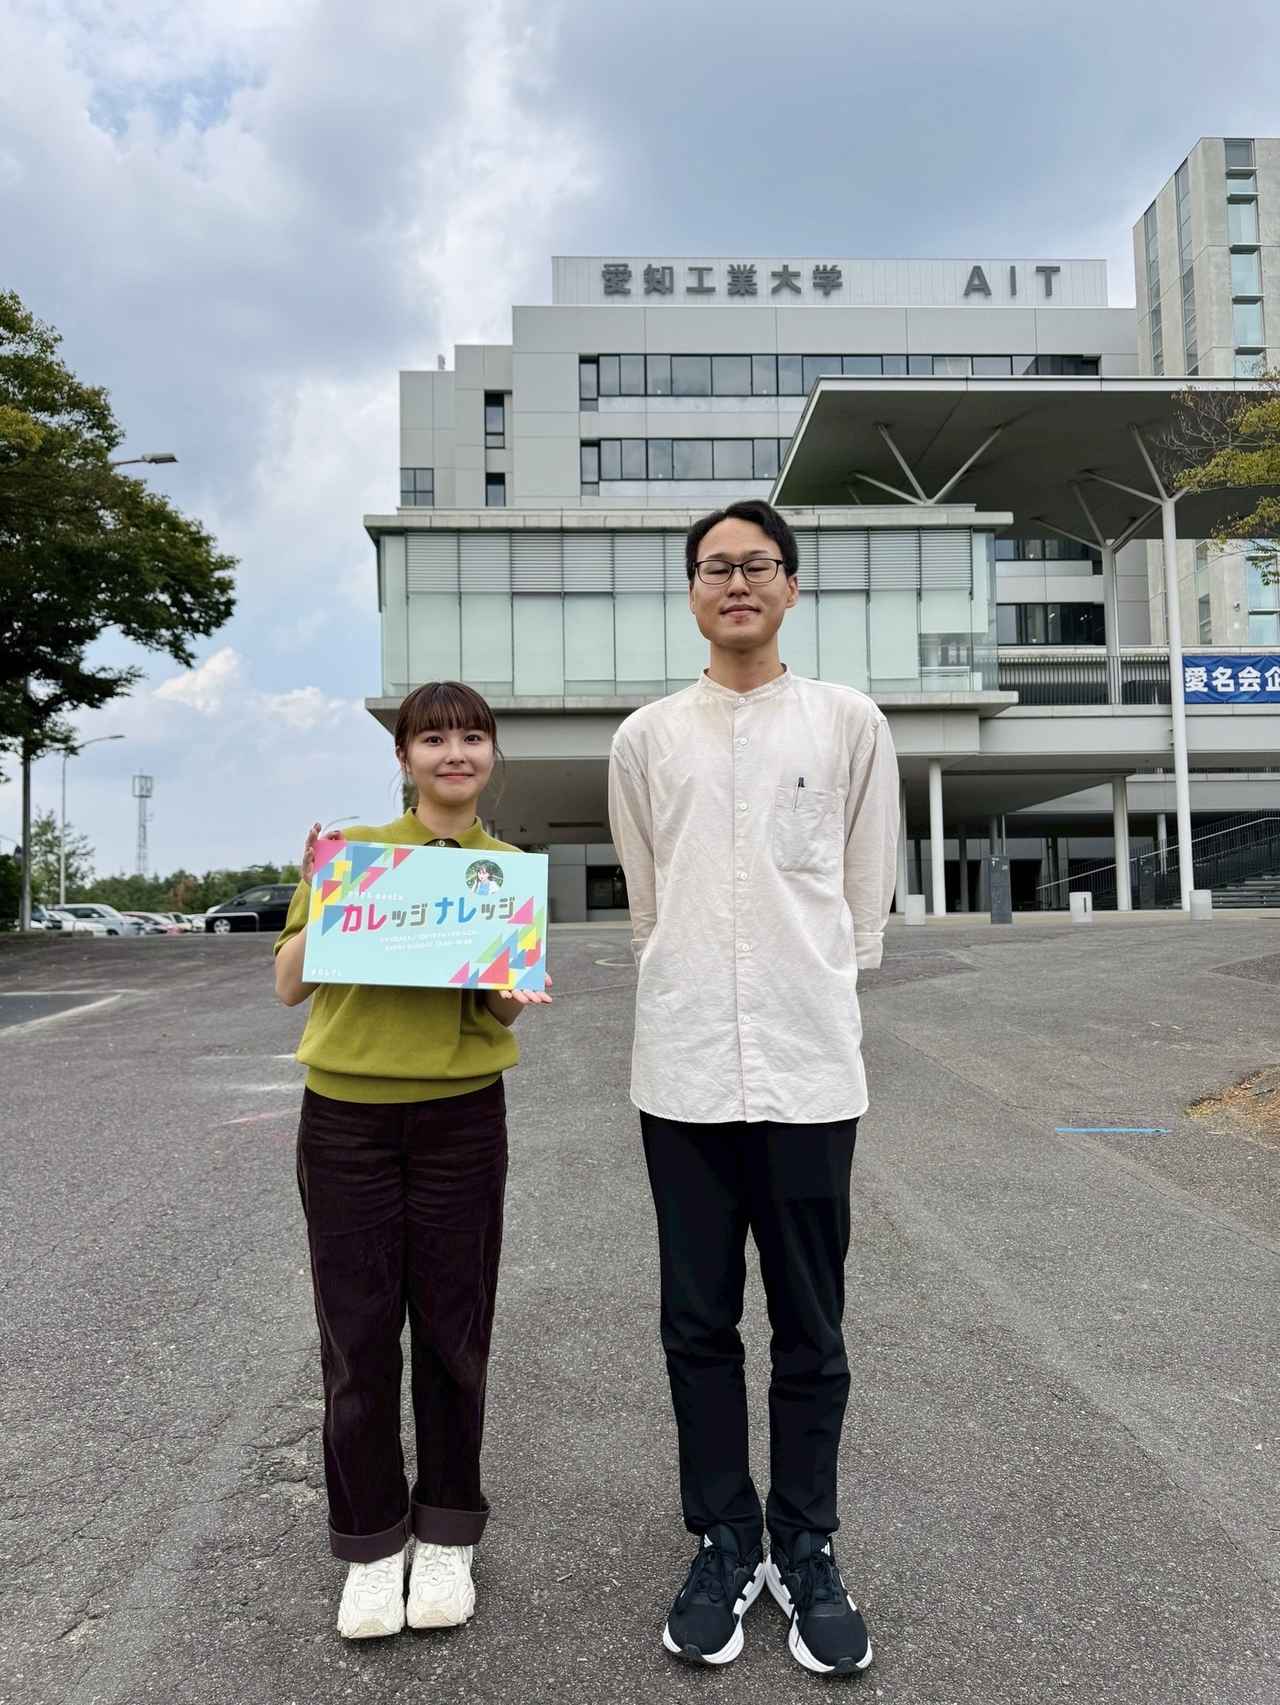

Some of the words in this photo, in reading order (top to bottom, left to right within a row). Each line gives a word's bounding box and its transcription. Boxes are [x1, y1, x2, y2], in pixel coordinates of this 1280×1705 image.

[601, 263, 843, 297] 愛知工業大学
[963, 265, 1060, 297] AIT
